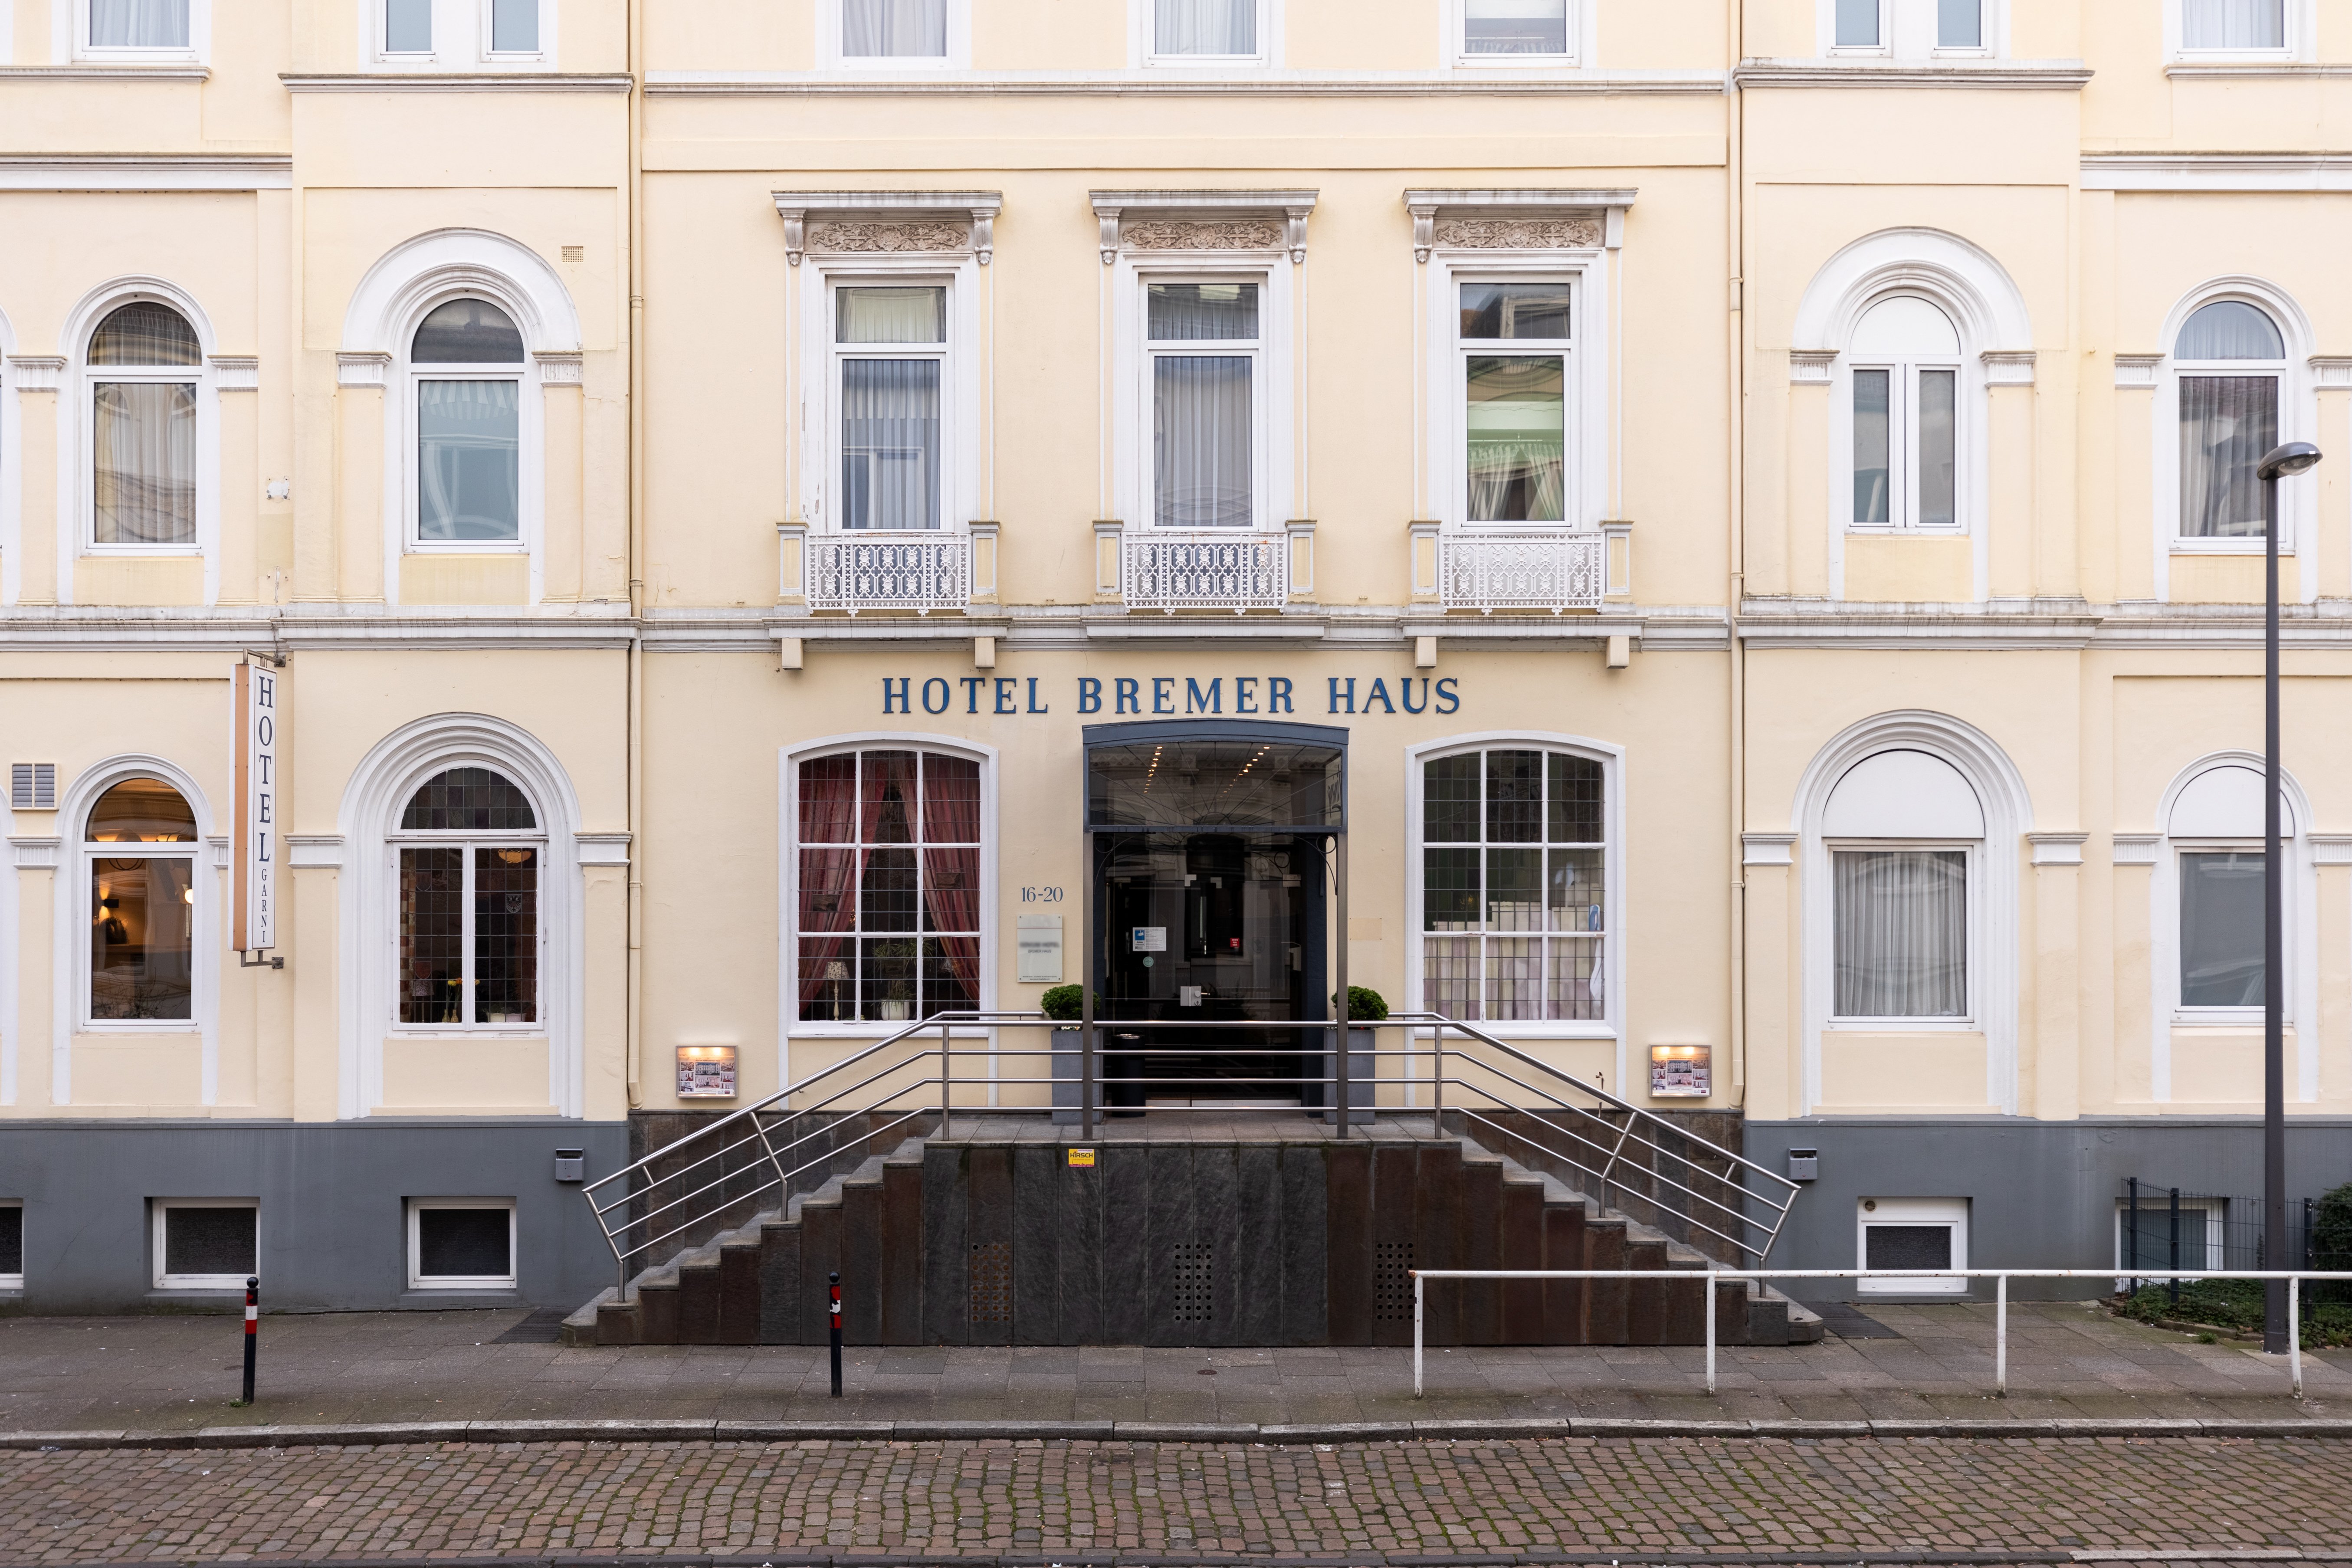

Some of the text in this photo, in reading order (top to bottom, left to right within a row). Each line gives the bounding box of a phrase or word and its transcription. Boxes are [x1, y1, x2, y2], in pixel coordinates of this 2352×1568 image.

[882, 677, 1460, 715] HOTEL BREMER HAUS
[259, 676, 273, 863] HOTEL
[1021, 886, 1063, 902] 16-20
